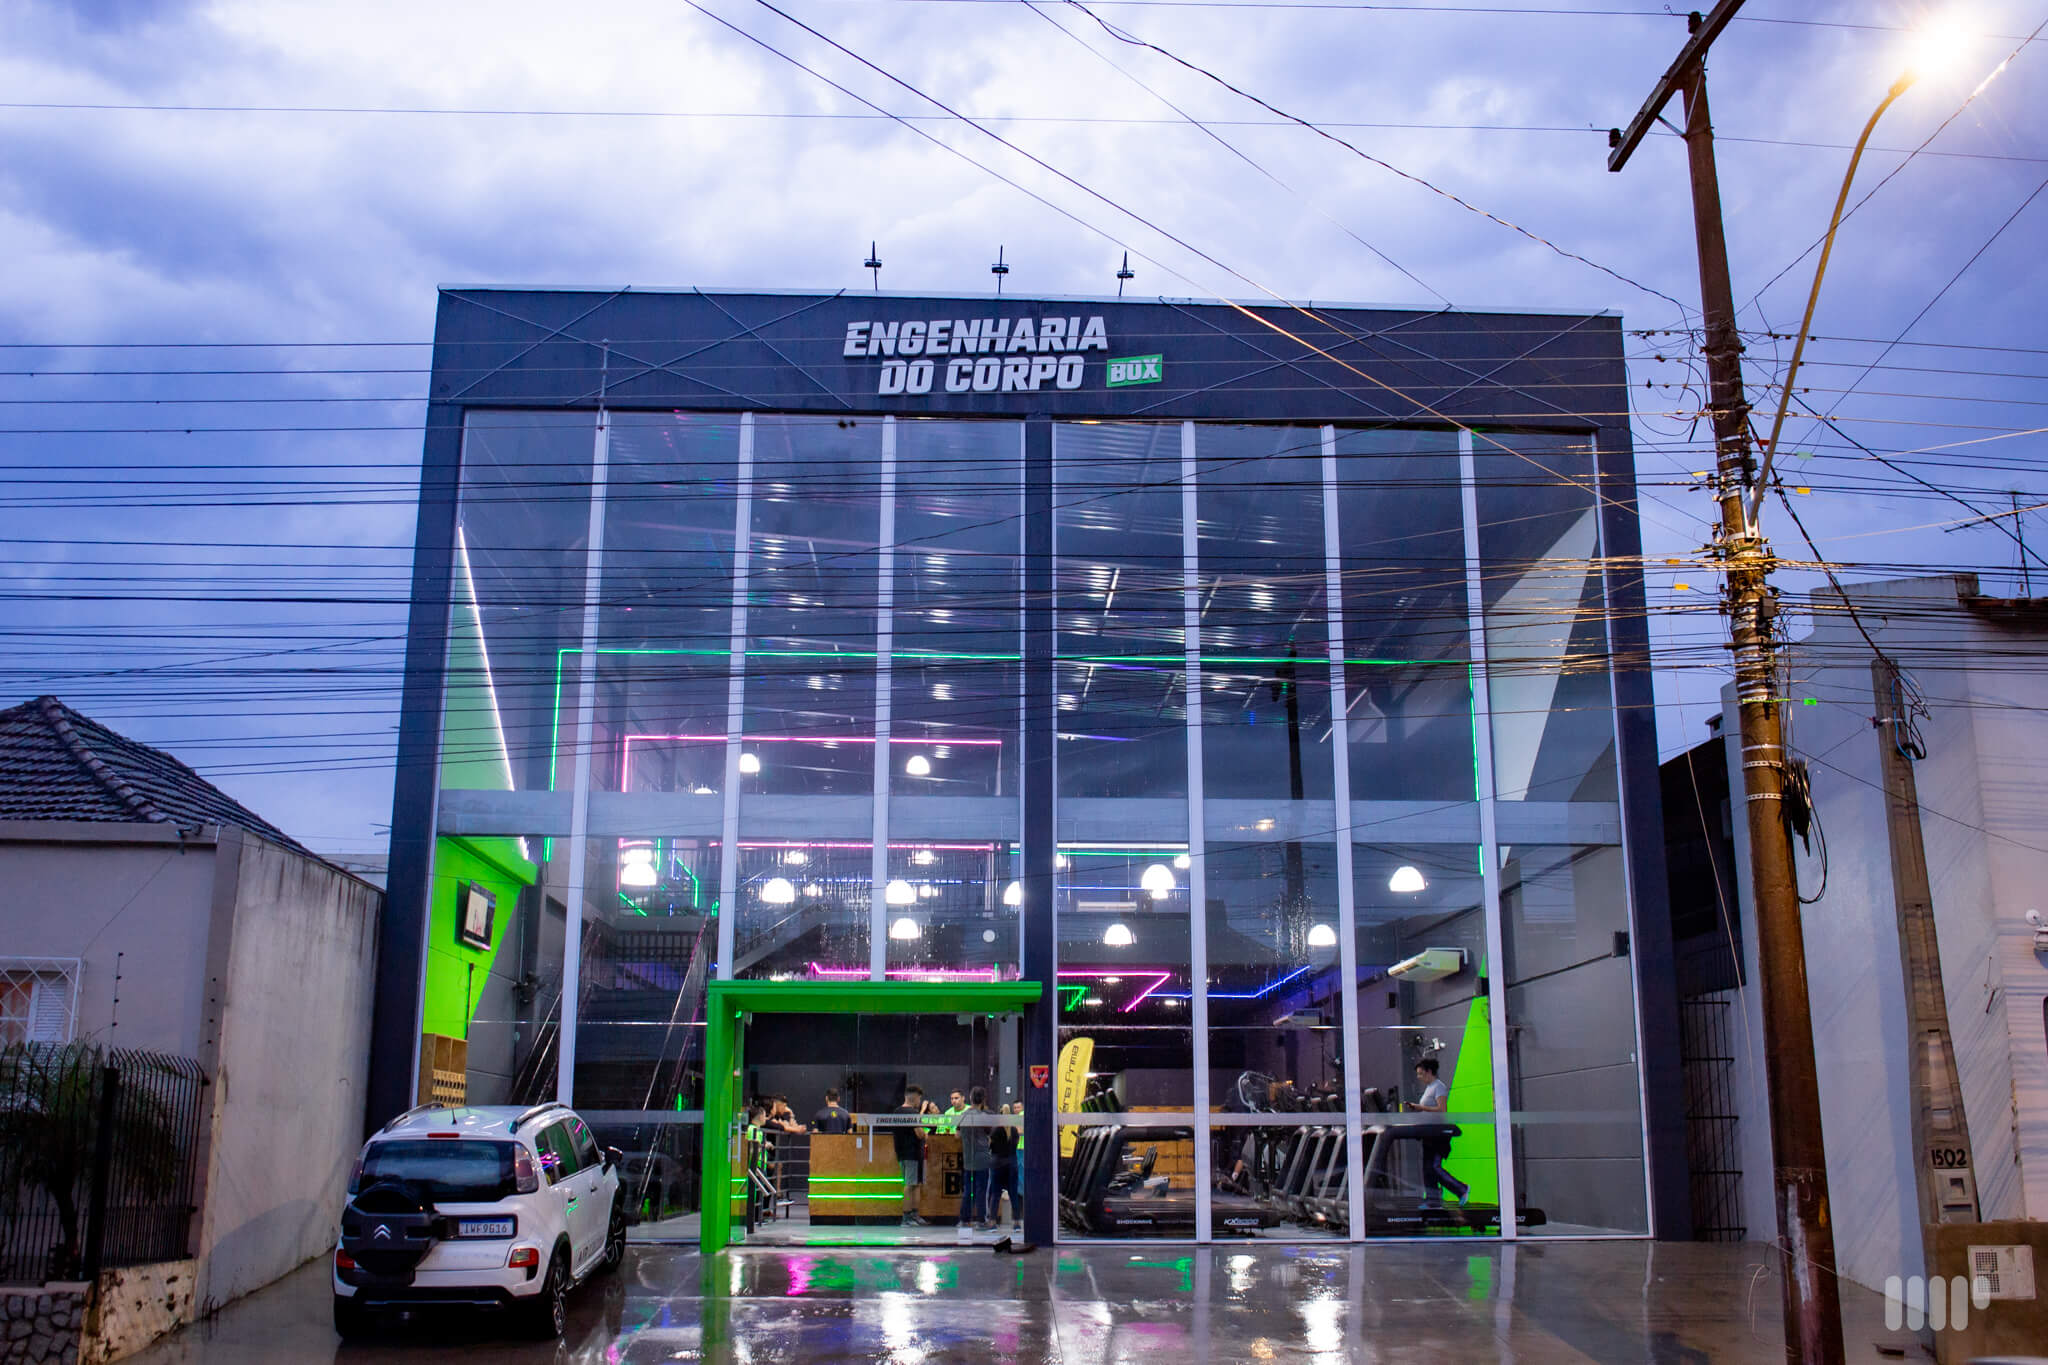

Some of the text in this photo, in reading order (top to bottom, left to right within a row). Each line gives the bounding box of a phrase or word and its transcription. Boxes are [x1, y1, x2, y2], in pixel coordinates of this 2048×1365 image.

[843, 316, 1108, 356] ENGENHARIA
[878, 355, 1085, 395] DO CORPO
[1110, 357, 1160, 383] BOX
[1931, 1148, 1967, 1167] 1502
